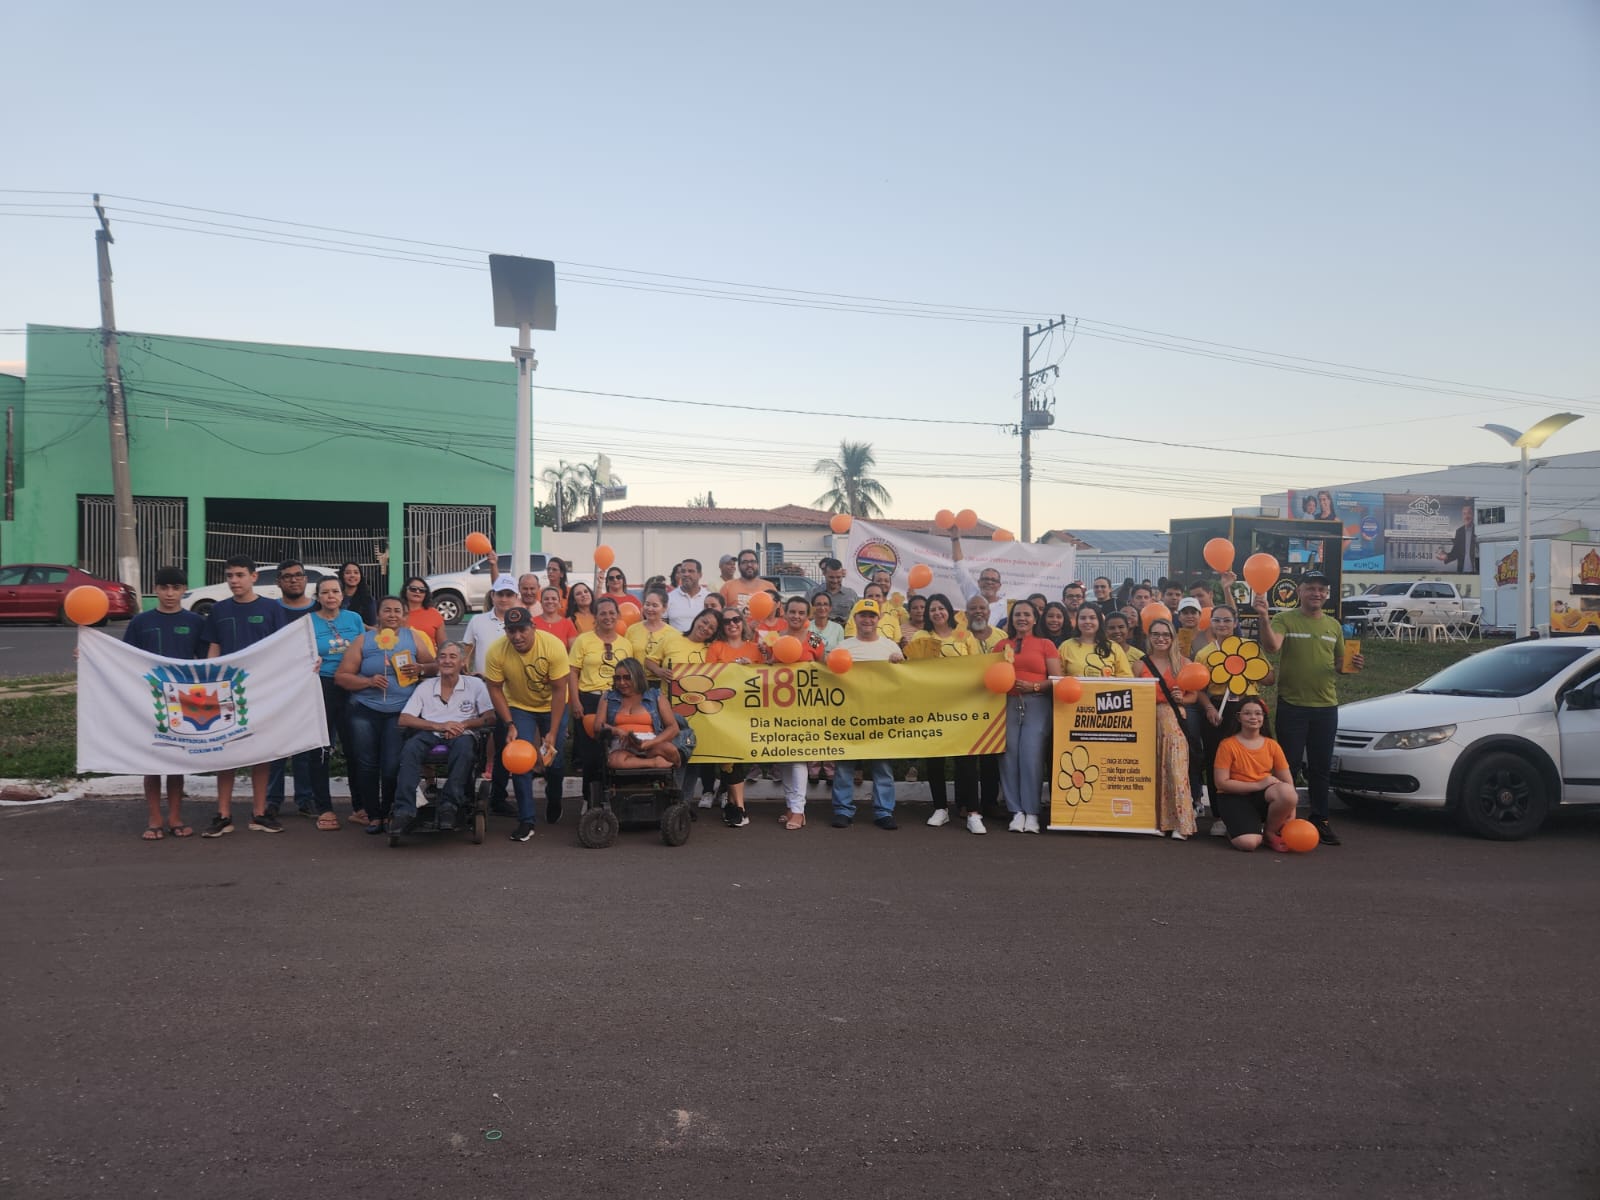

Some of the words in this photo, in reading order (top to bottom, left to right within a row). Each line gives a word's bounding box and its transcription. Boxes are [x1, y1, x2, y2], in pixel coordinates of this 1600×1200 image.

[744, 675, 760, 708] DIA
[756, 667, 796, 708] 18
[797, 669, 819, 687] DE
[797, 687, 846, 707] MAIO
[1096, 692, 1122, 711] NÃO
[1123, 690, 1132, 709] É
[750, 717, 770, 728] Dia
[774, 716, 827, 728] Nacional
[831, 716, 846, 727] de
[849, 715, 905, 727] Combate
[908, 715, 924, 723] ao
[927, 712, 968, 722] Abuso
[971, 712, 979, 720] e
[982, 712, 990, 720] a
[1074, 714, 1133, 729] BRINCADEIRA
[751, 731, 820, 744] Exploração
[823, 730, 865, 741] Sexual
[869, 730, 884, 740] de
[887, 728, 943, 740] Crianças
[750, 748, 758, 757] e
[760, 746, 846, 757] Adolescentes
